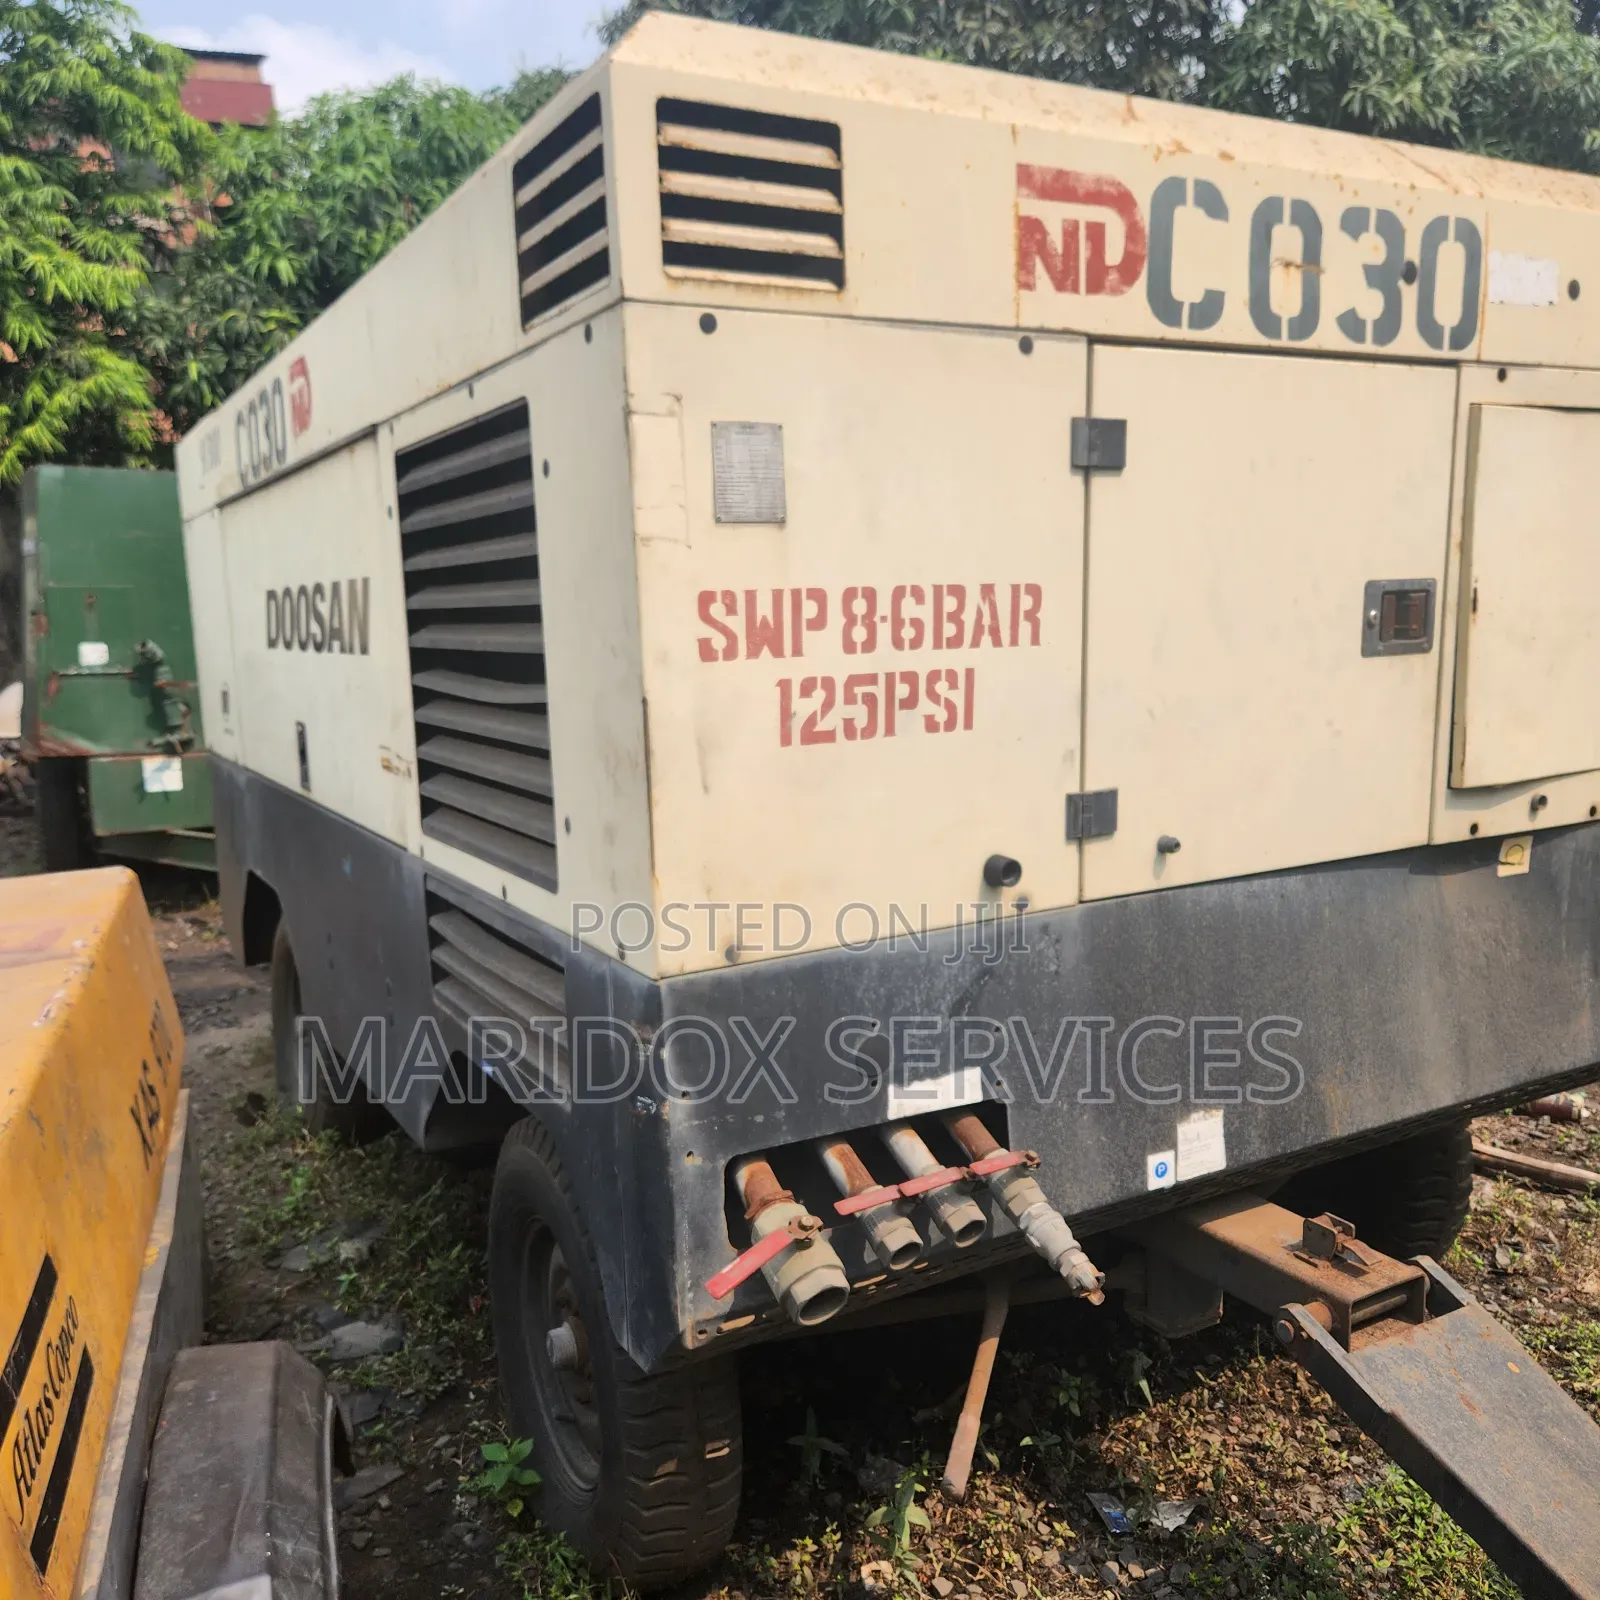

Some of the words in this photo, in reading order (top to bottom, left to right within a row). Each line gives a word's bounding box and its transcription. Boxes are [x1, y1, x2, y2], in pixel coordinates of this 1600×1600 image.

[266, 577, 370, 656] DOOSAN
[697, 586, 829, 663] SWP
[774, 667, 975, 748] 125PSI
[13, 1382, 55, 1526] Atlas
[46, 1295, 79, 1401] Copco
